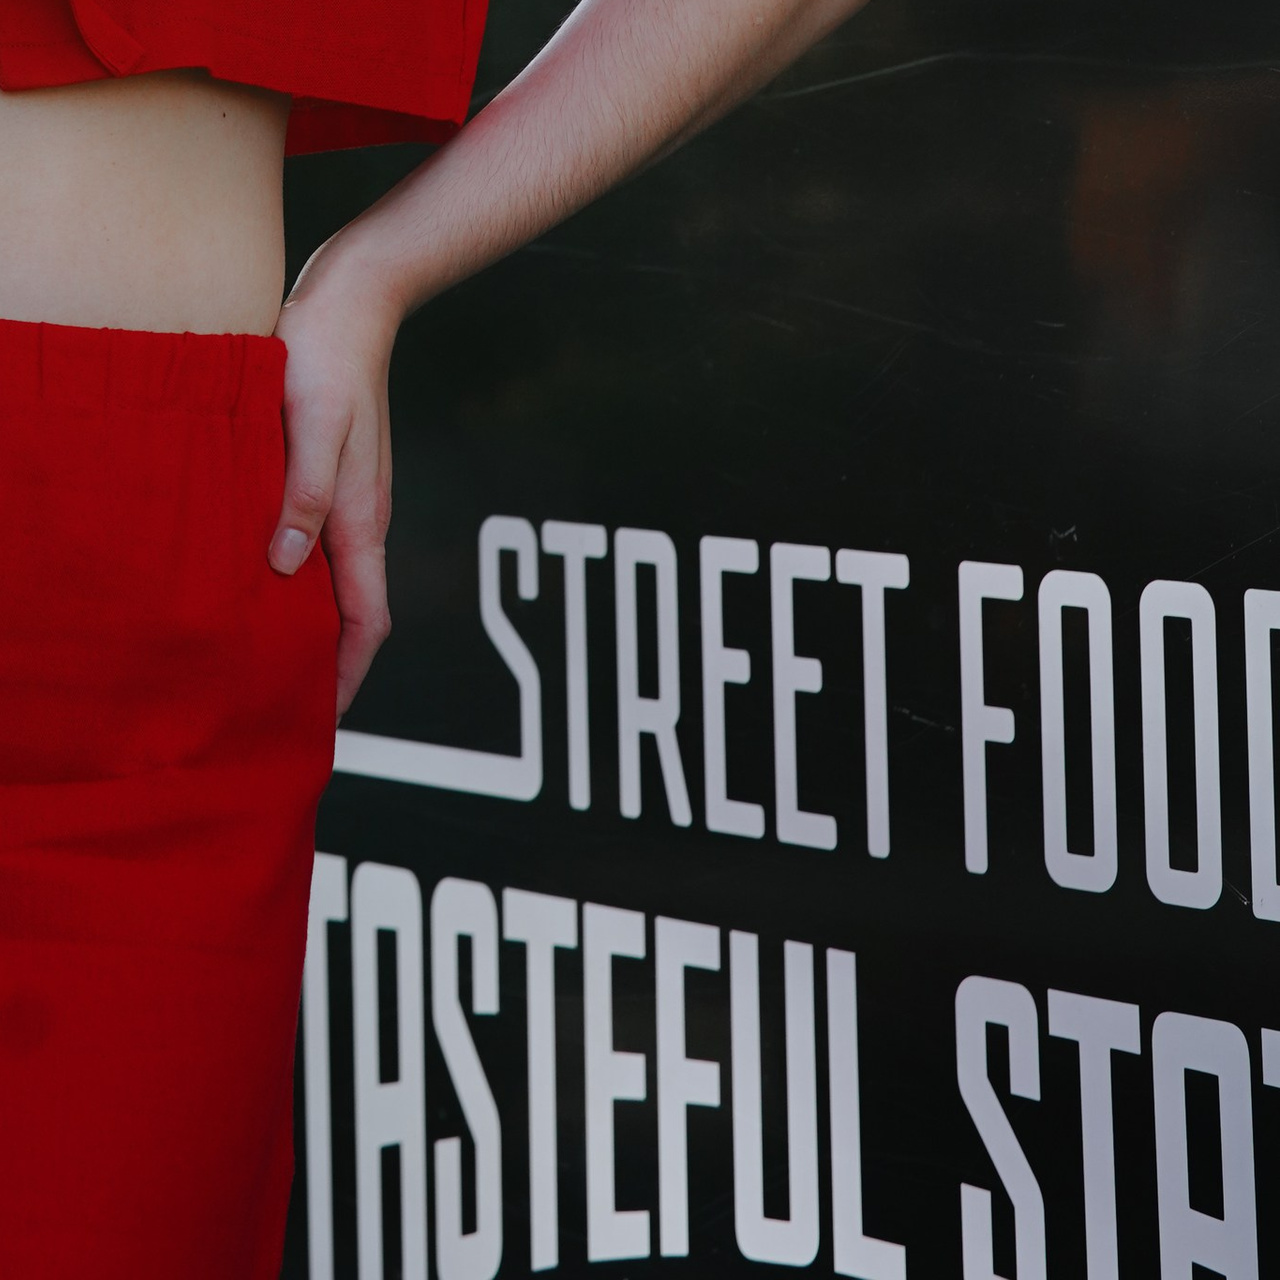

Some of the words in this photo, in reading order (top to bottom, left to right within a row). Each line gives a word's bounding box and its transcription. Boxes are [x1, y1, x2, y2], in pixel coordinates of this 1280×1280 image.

[333, 515, 910, 858] STREET
[302, 851, 906, 1280] TASTEFUL
[955, 975, 1280, 1280] STA
